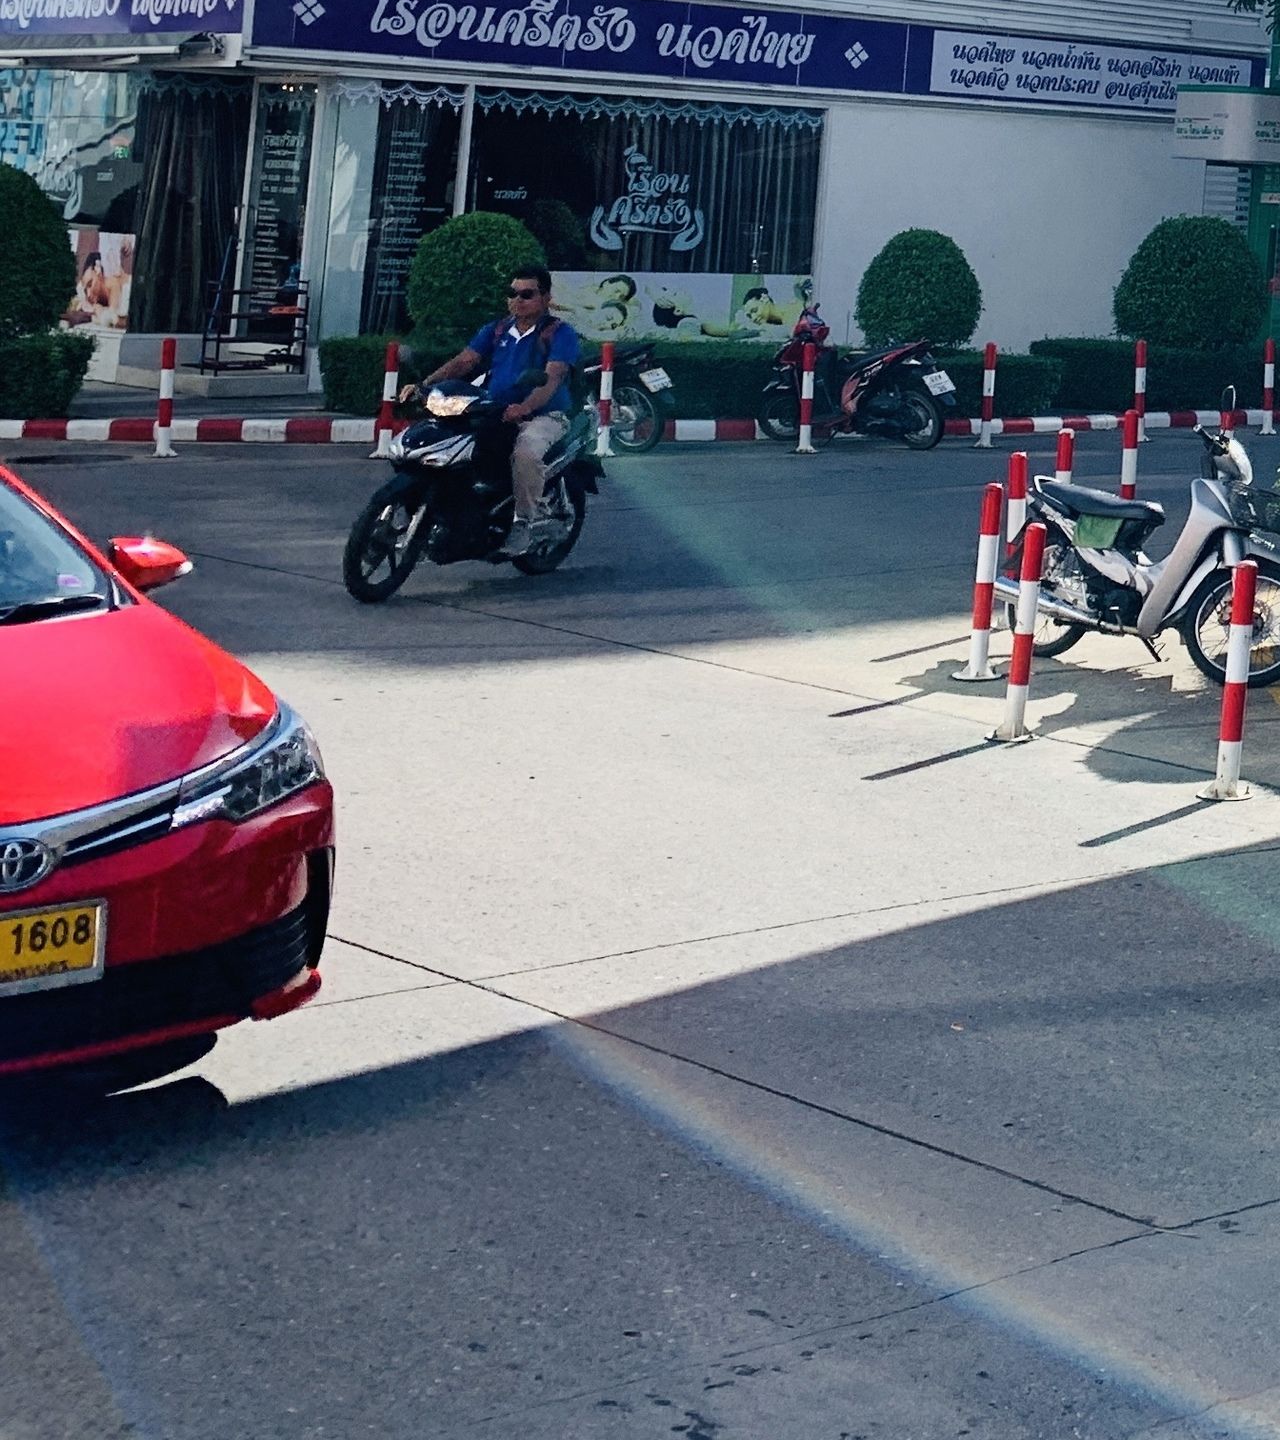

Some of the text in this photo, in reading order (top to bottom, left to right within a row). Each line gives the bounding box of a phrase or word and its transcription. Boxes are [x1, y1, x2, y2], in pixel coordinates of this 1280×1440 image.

[656, 15, 816, 69] นวดไทย
[952, 41, 1015, 65] นวดไทย
[1022, 45, 1101, 72] นวดน้ำมัน
[950, 67, 1009, 90] นวดตัว
[1016, 74, 1100, 94] นวดประคบ
[11, 913, 91, 955] 1608
